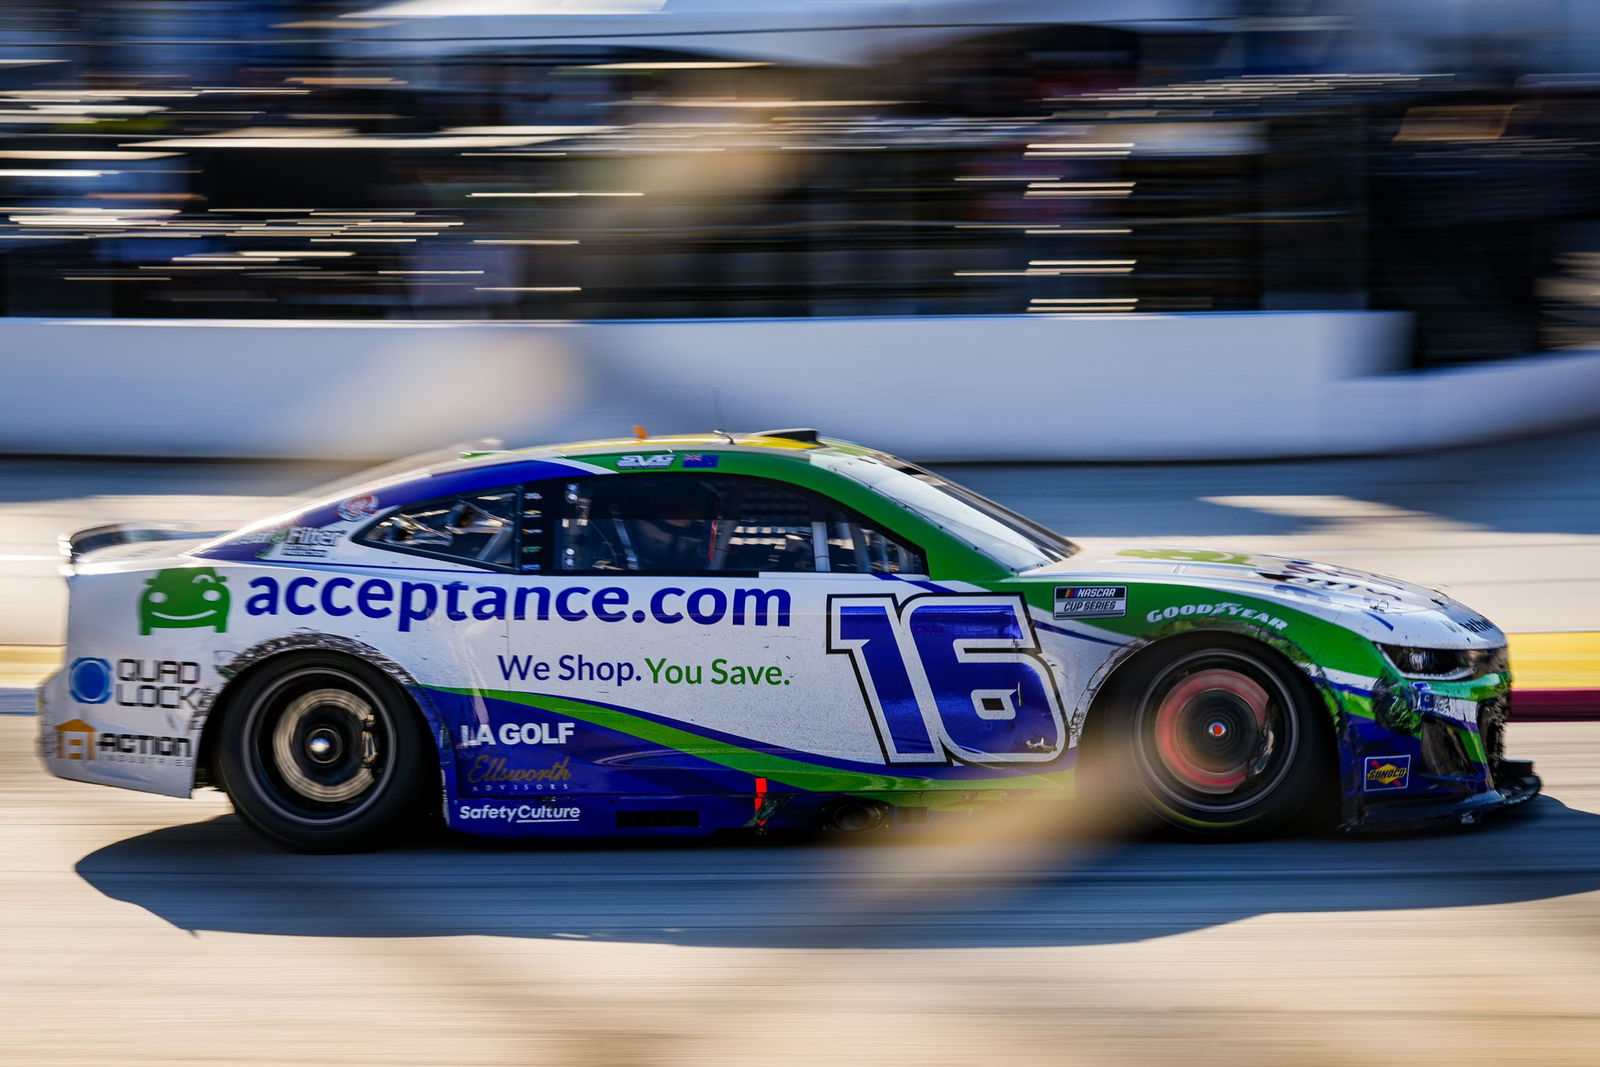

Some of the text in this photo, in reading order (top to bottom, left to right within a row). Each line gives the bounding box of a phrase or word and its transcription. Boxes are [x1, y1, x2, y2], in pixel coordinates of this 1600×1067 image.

[246, 575, 792, 632] acceptance.com
[1063, 599, 1117, 612] CUP SERIES
[1077, 587, 1116, 598] NASCAR
[1147, 601, 1288, 631] GOODYEAR
[117, 658, 200, 684] QUAD
[497, 654, 791, 687] We Shop. You Save.
[826, 592, 1070, 767] 16
[116, 683, 199, 710] LOCK
[98, 731, 192, 757] ACTION
[460, 722, 575, 746] LA GOLF
[467, 754, 572, 783] Ellsworth
[1368, 769, 1406, 780] SUNOCO
[472, 783, 569, 792] ADVISORS
[459, 804, 581, 823] SafetyCulture
